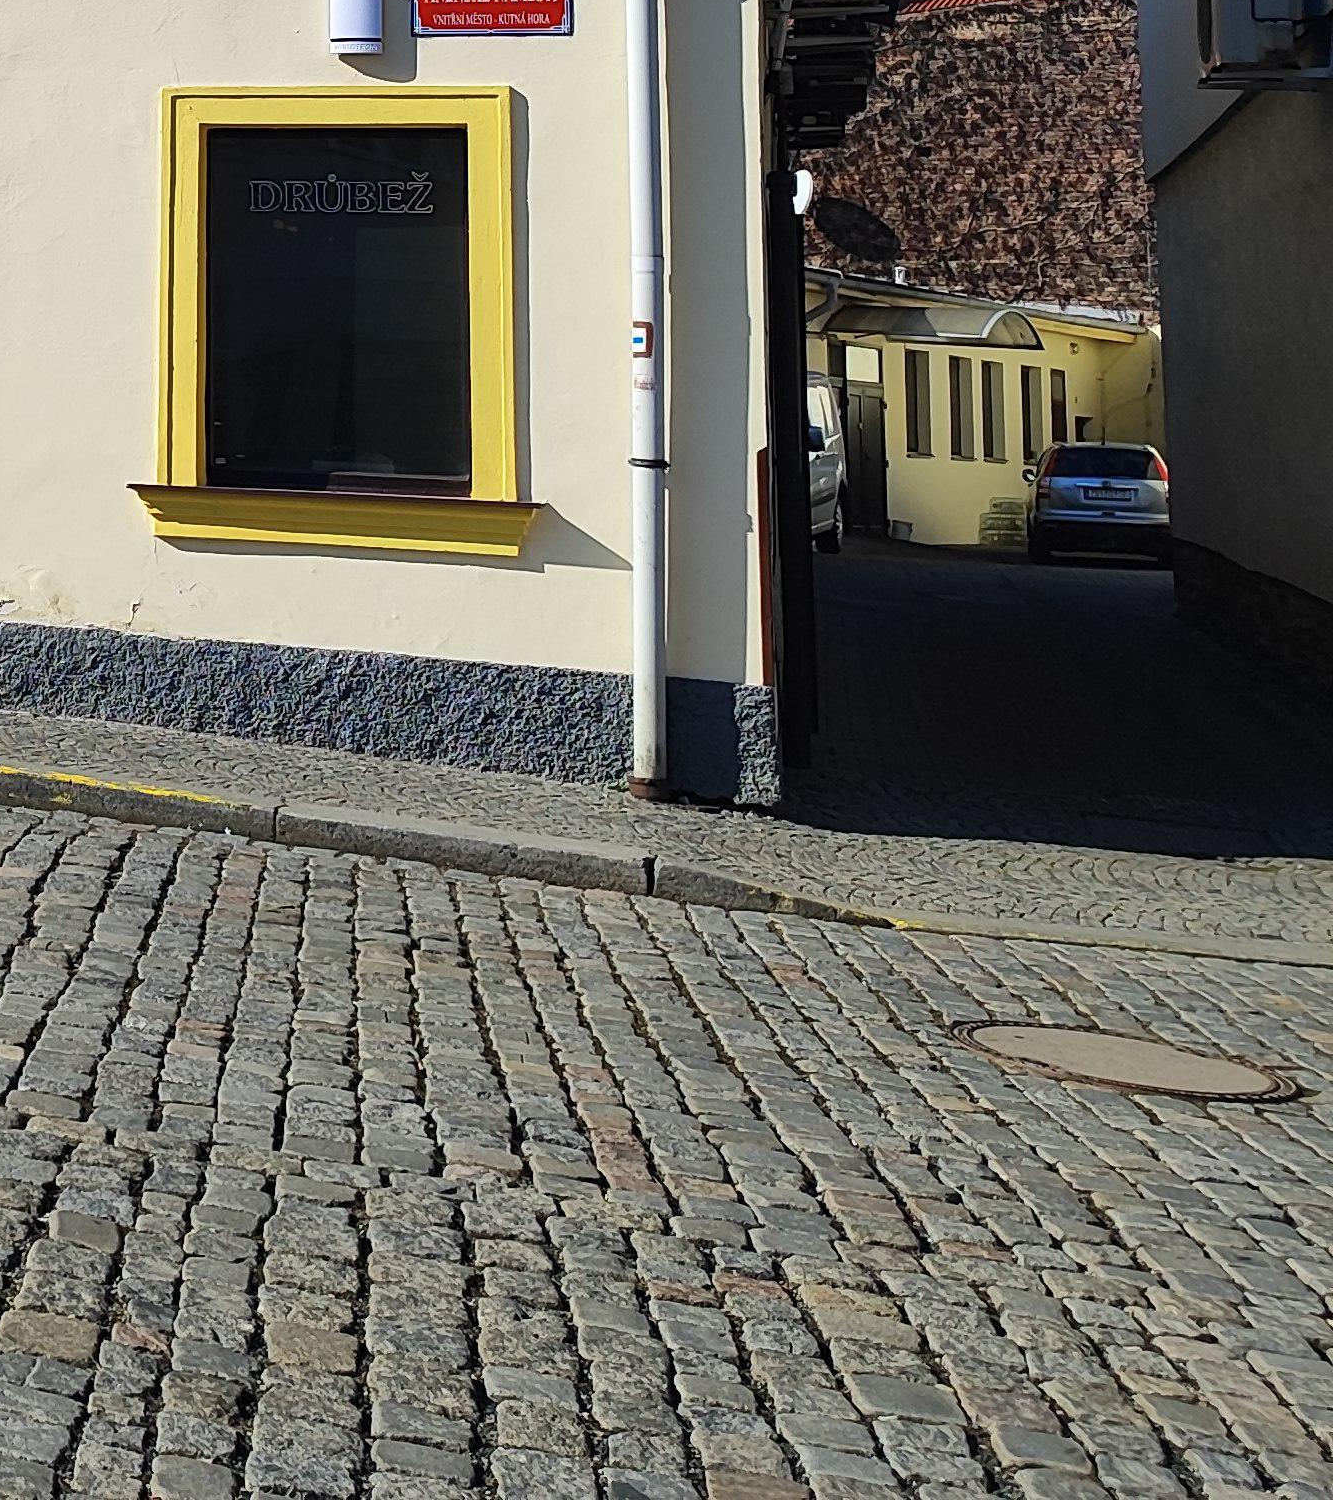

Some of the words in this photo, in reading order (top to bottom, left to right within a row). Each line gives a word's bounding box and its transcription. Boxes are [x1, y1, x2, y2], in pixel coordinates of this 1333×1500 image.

[498, 11, 526, 25] KUTNÁ
[527, 13, 551, 25] HORA
[248, 170, 435, 214] DRŮBEŽ
